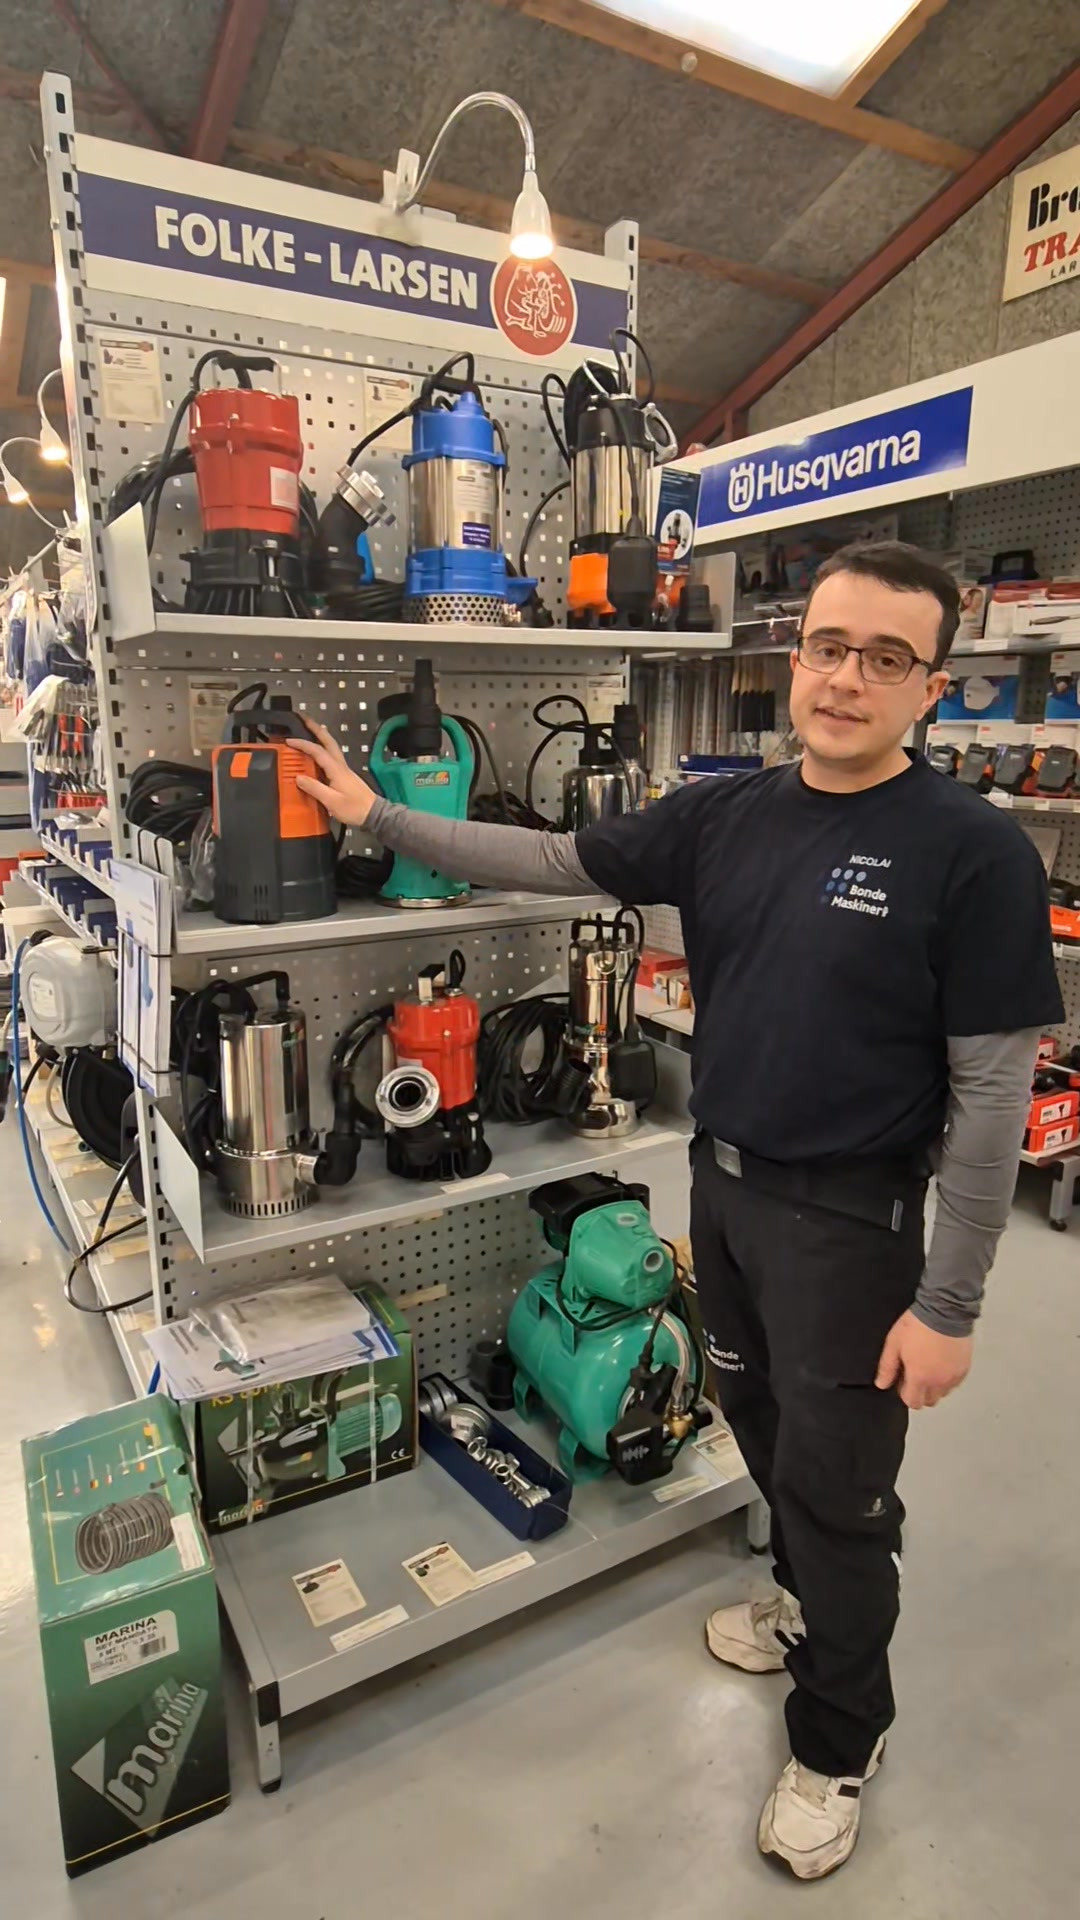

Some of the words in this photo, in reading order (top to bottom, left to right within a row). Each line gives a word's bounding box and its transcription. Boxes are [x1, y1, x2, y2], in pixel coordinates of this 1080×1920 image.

[329, 242, 478, 310] LARSEN
[755, 429, 922, 501] Husqvarna
[848, 854, 892, 869] NICOLAI
[849, 883, 887, 902] Bonde
[95, 1616, 157, 1645] MARINA
[107, 1682, 200, 1815] marina
